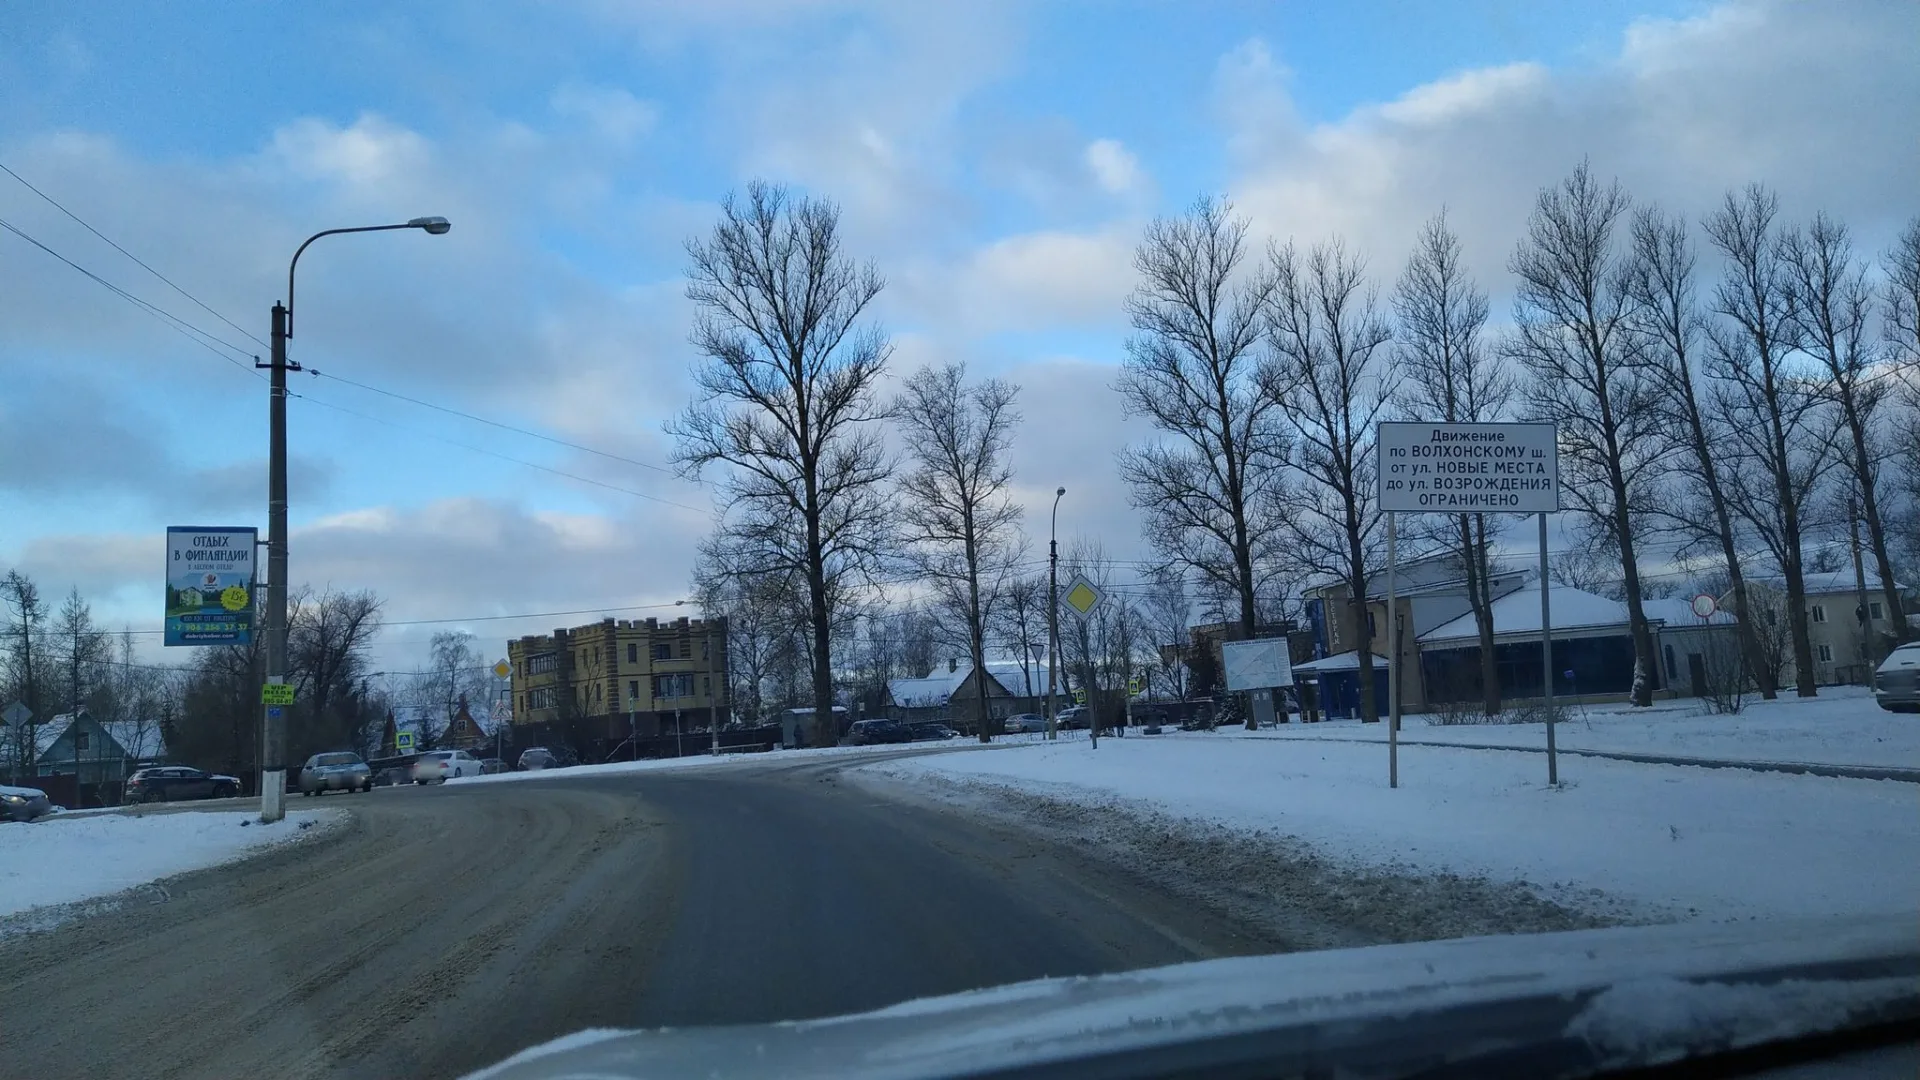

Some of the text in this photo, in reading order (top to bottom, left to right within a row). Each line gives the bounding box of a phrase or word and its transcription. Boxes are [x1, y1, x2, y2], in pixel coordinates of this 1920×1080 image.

[1431, 429, 1505, 443] Движение
[1390, 445, 1547, 458] по ВОЛХОНСКОМУ ш.
[1391, 461, 1546, 476] от ул. НОВЫЕ МЕСТА
[1386, 477, 1551, 492] до ул. ВОЗРОЖДЕНИЯ
[1419, 493, 1519, 506] ОГРАНИЧЕНО
[193, 536, 230, 548] ОТДЫХ
[174, 550, 248, 562] В ФИНЛЯНДИИ
